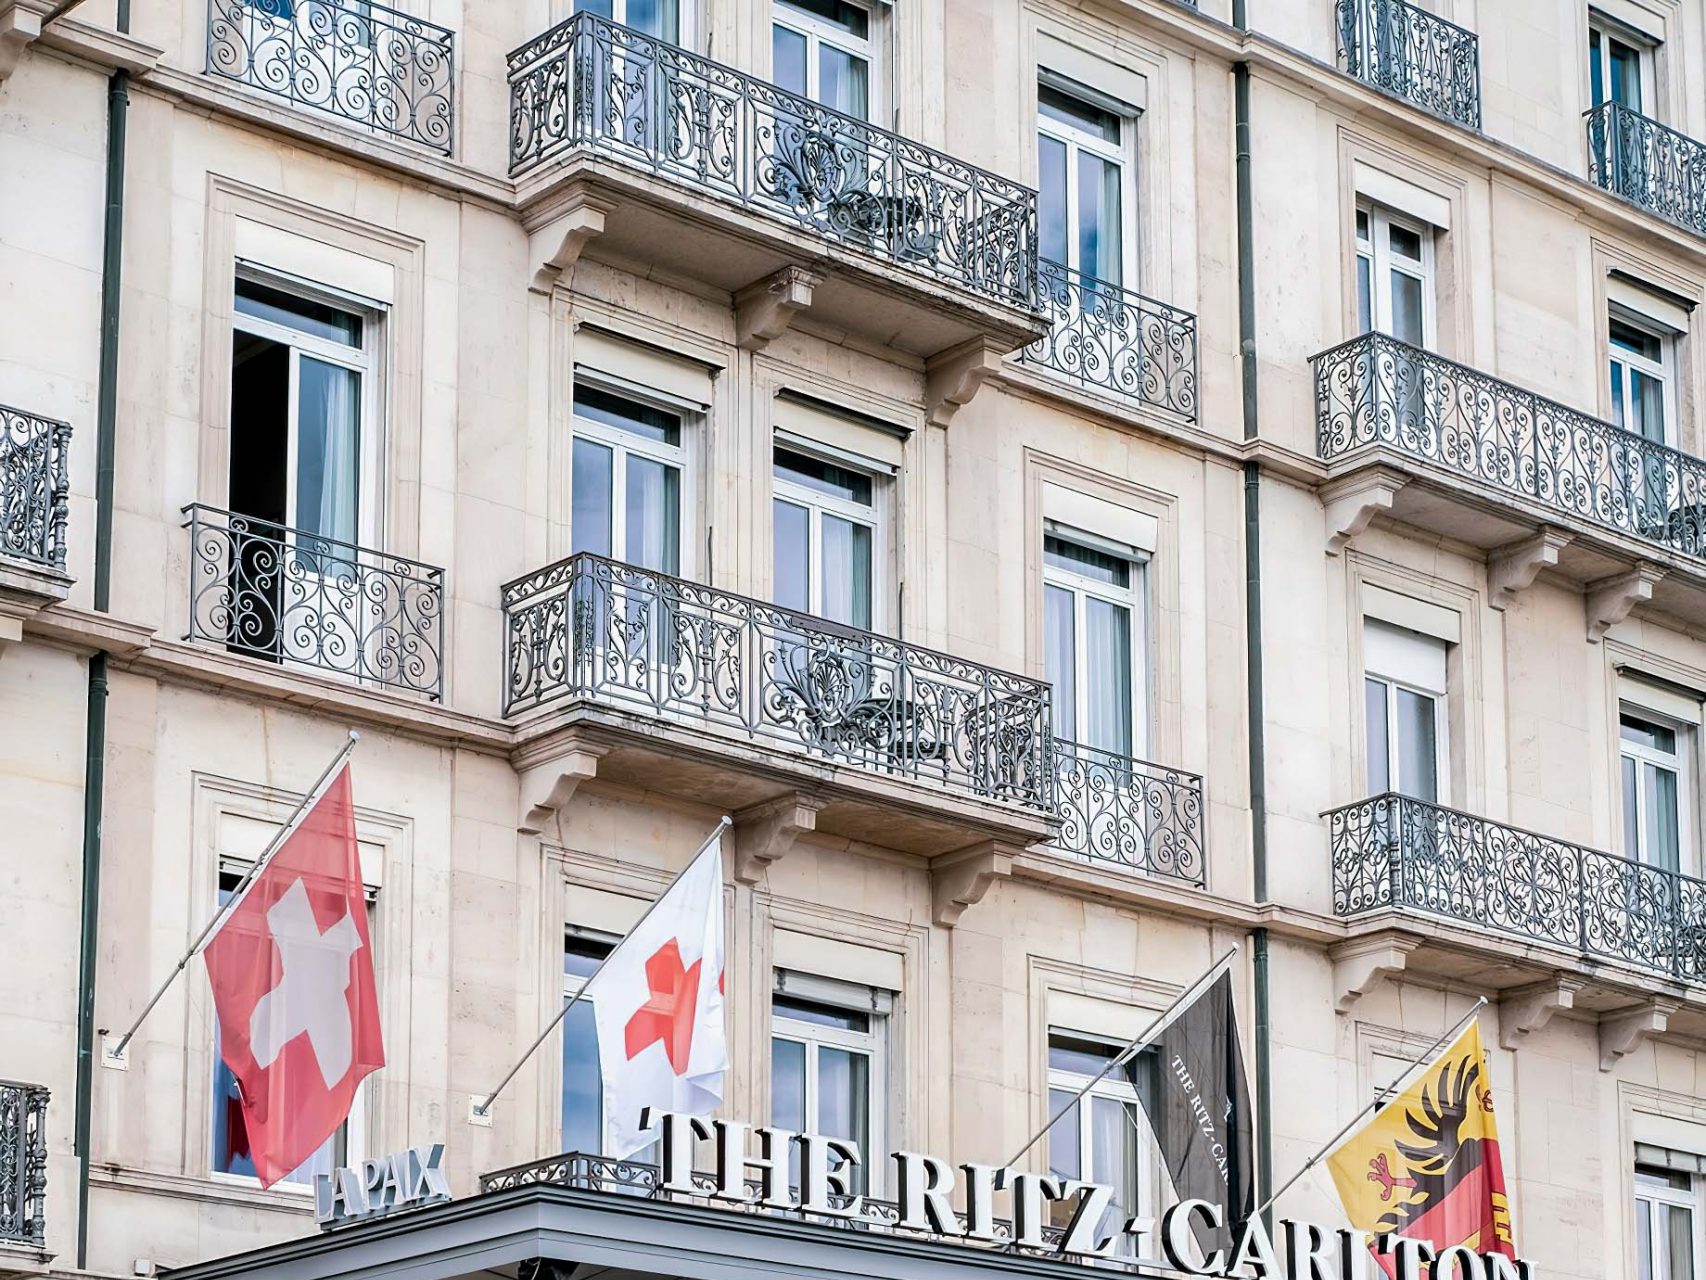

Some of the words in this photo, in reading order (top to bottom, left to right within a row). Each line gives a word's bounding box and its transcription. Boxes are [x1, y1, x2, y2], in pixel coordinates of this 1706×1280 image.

[1171, 1054, 1195, 1094] THE
[313, 1166, 366, 1224] LA
[361, 1143, 452, 1211] PAIX
[639, 1106, 863, 1219] THE
